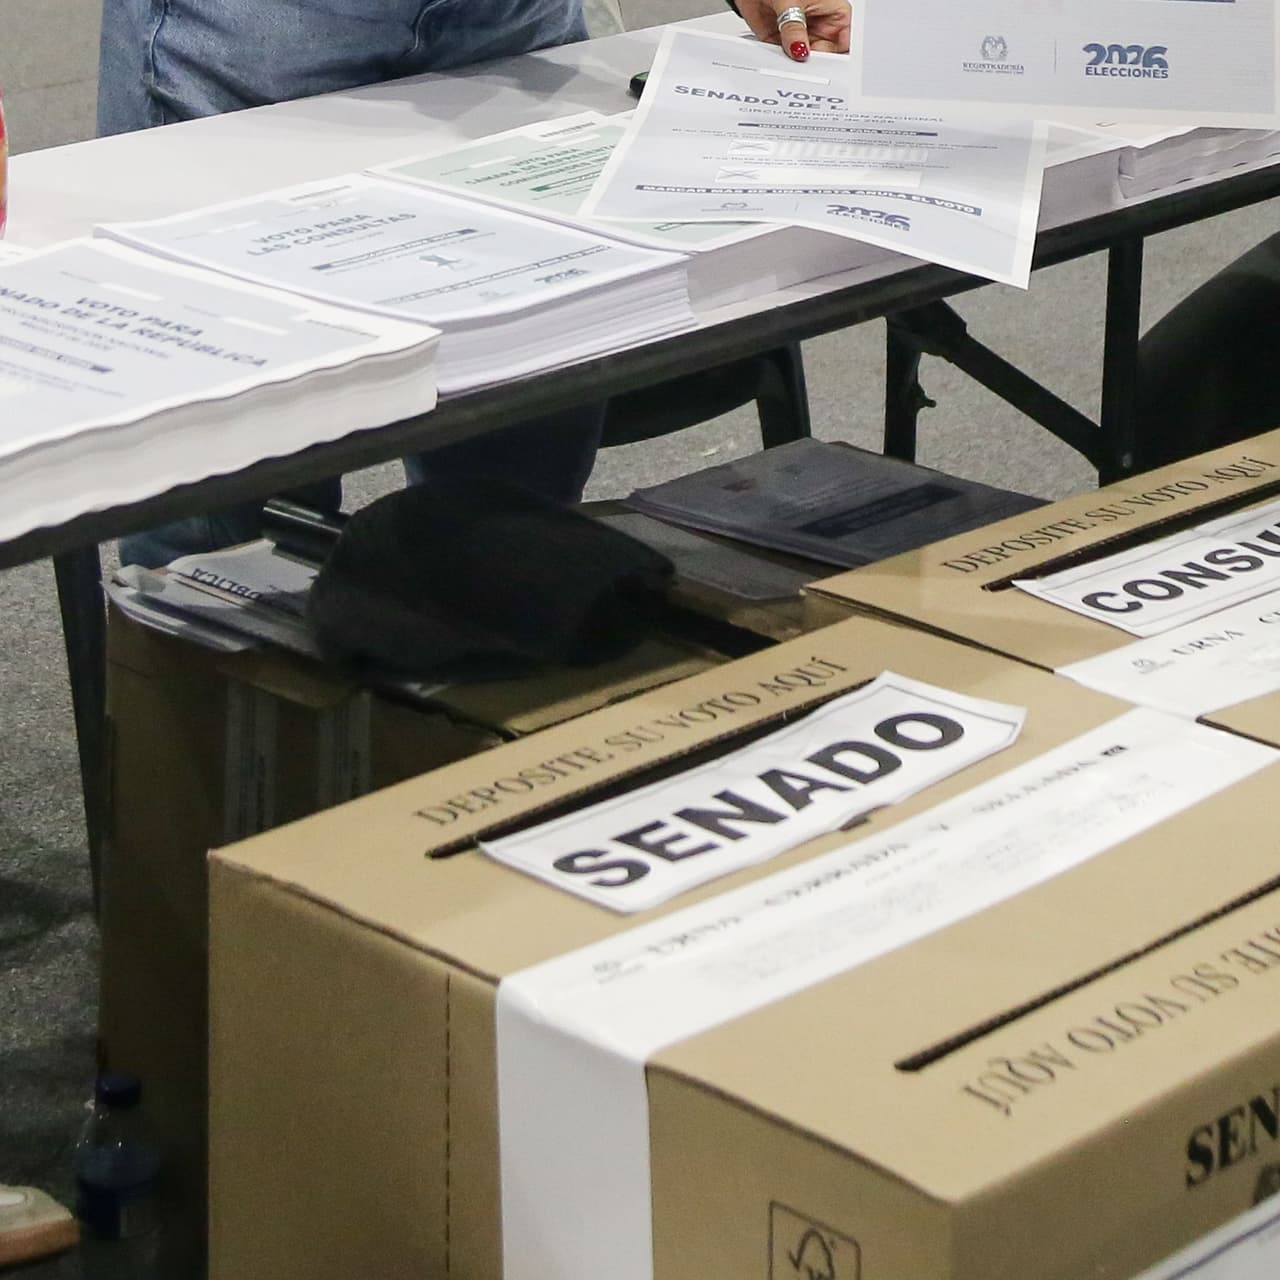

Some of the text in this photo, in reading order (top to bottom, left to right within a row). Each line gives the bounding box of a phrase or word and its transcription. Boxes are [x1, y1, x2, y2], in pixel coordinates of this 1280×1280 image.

[1082, 42, 1169, 69] 2026
[1085, 65, 1169, 79] ELECCIONES
[673, 85, 779, 106] SENADO
[787, 101, 821, 110] DE
[777, 89, 844, 104] VOTO
[933, 198, 977, 215] VOTO
[941, 455, 1279, 574] DEPOSITE SU VOTO AQUÍ
[1170, 628, 1245, 658] URNA
[412, 656, 850, 827] DEPOSITE SU VOTO AQUÍ
[552, 711, 966, 890] SENADO
[1169, 960, 1241, 1003] SU
[1066, 992, 1189, 1055] VOTO
[962, 1041, 1079, 1118] AQUÍ
